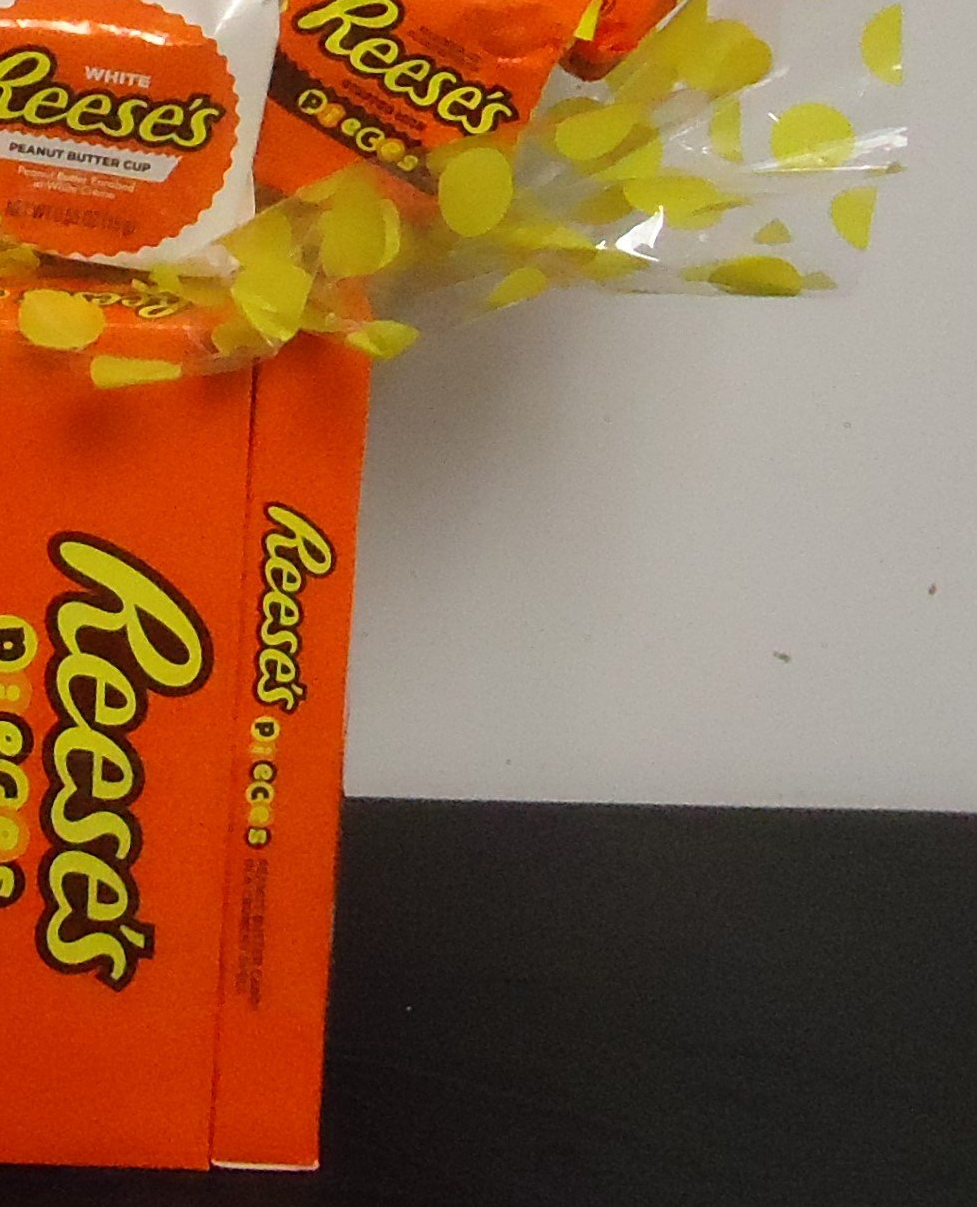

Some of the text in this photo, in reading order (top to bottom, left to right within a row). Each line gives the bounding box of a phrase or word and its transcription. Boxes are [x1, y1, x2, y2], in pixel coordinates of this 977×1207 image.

[84, 65, 152, 89] WHITE
[8, 141, 152, 174] PEANUT BUTTER CUP
[253, 501, 337, 714] Reese's
[35, 530, 215, 992] Reese's
